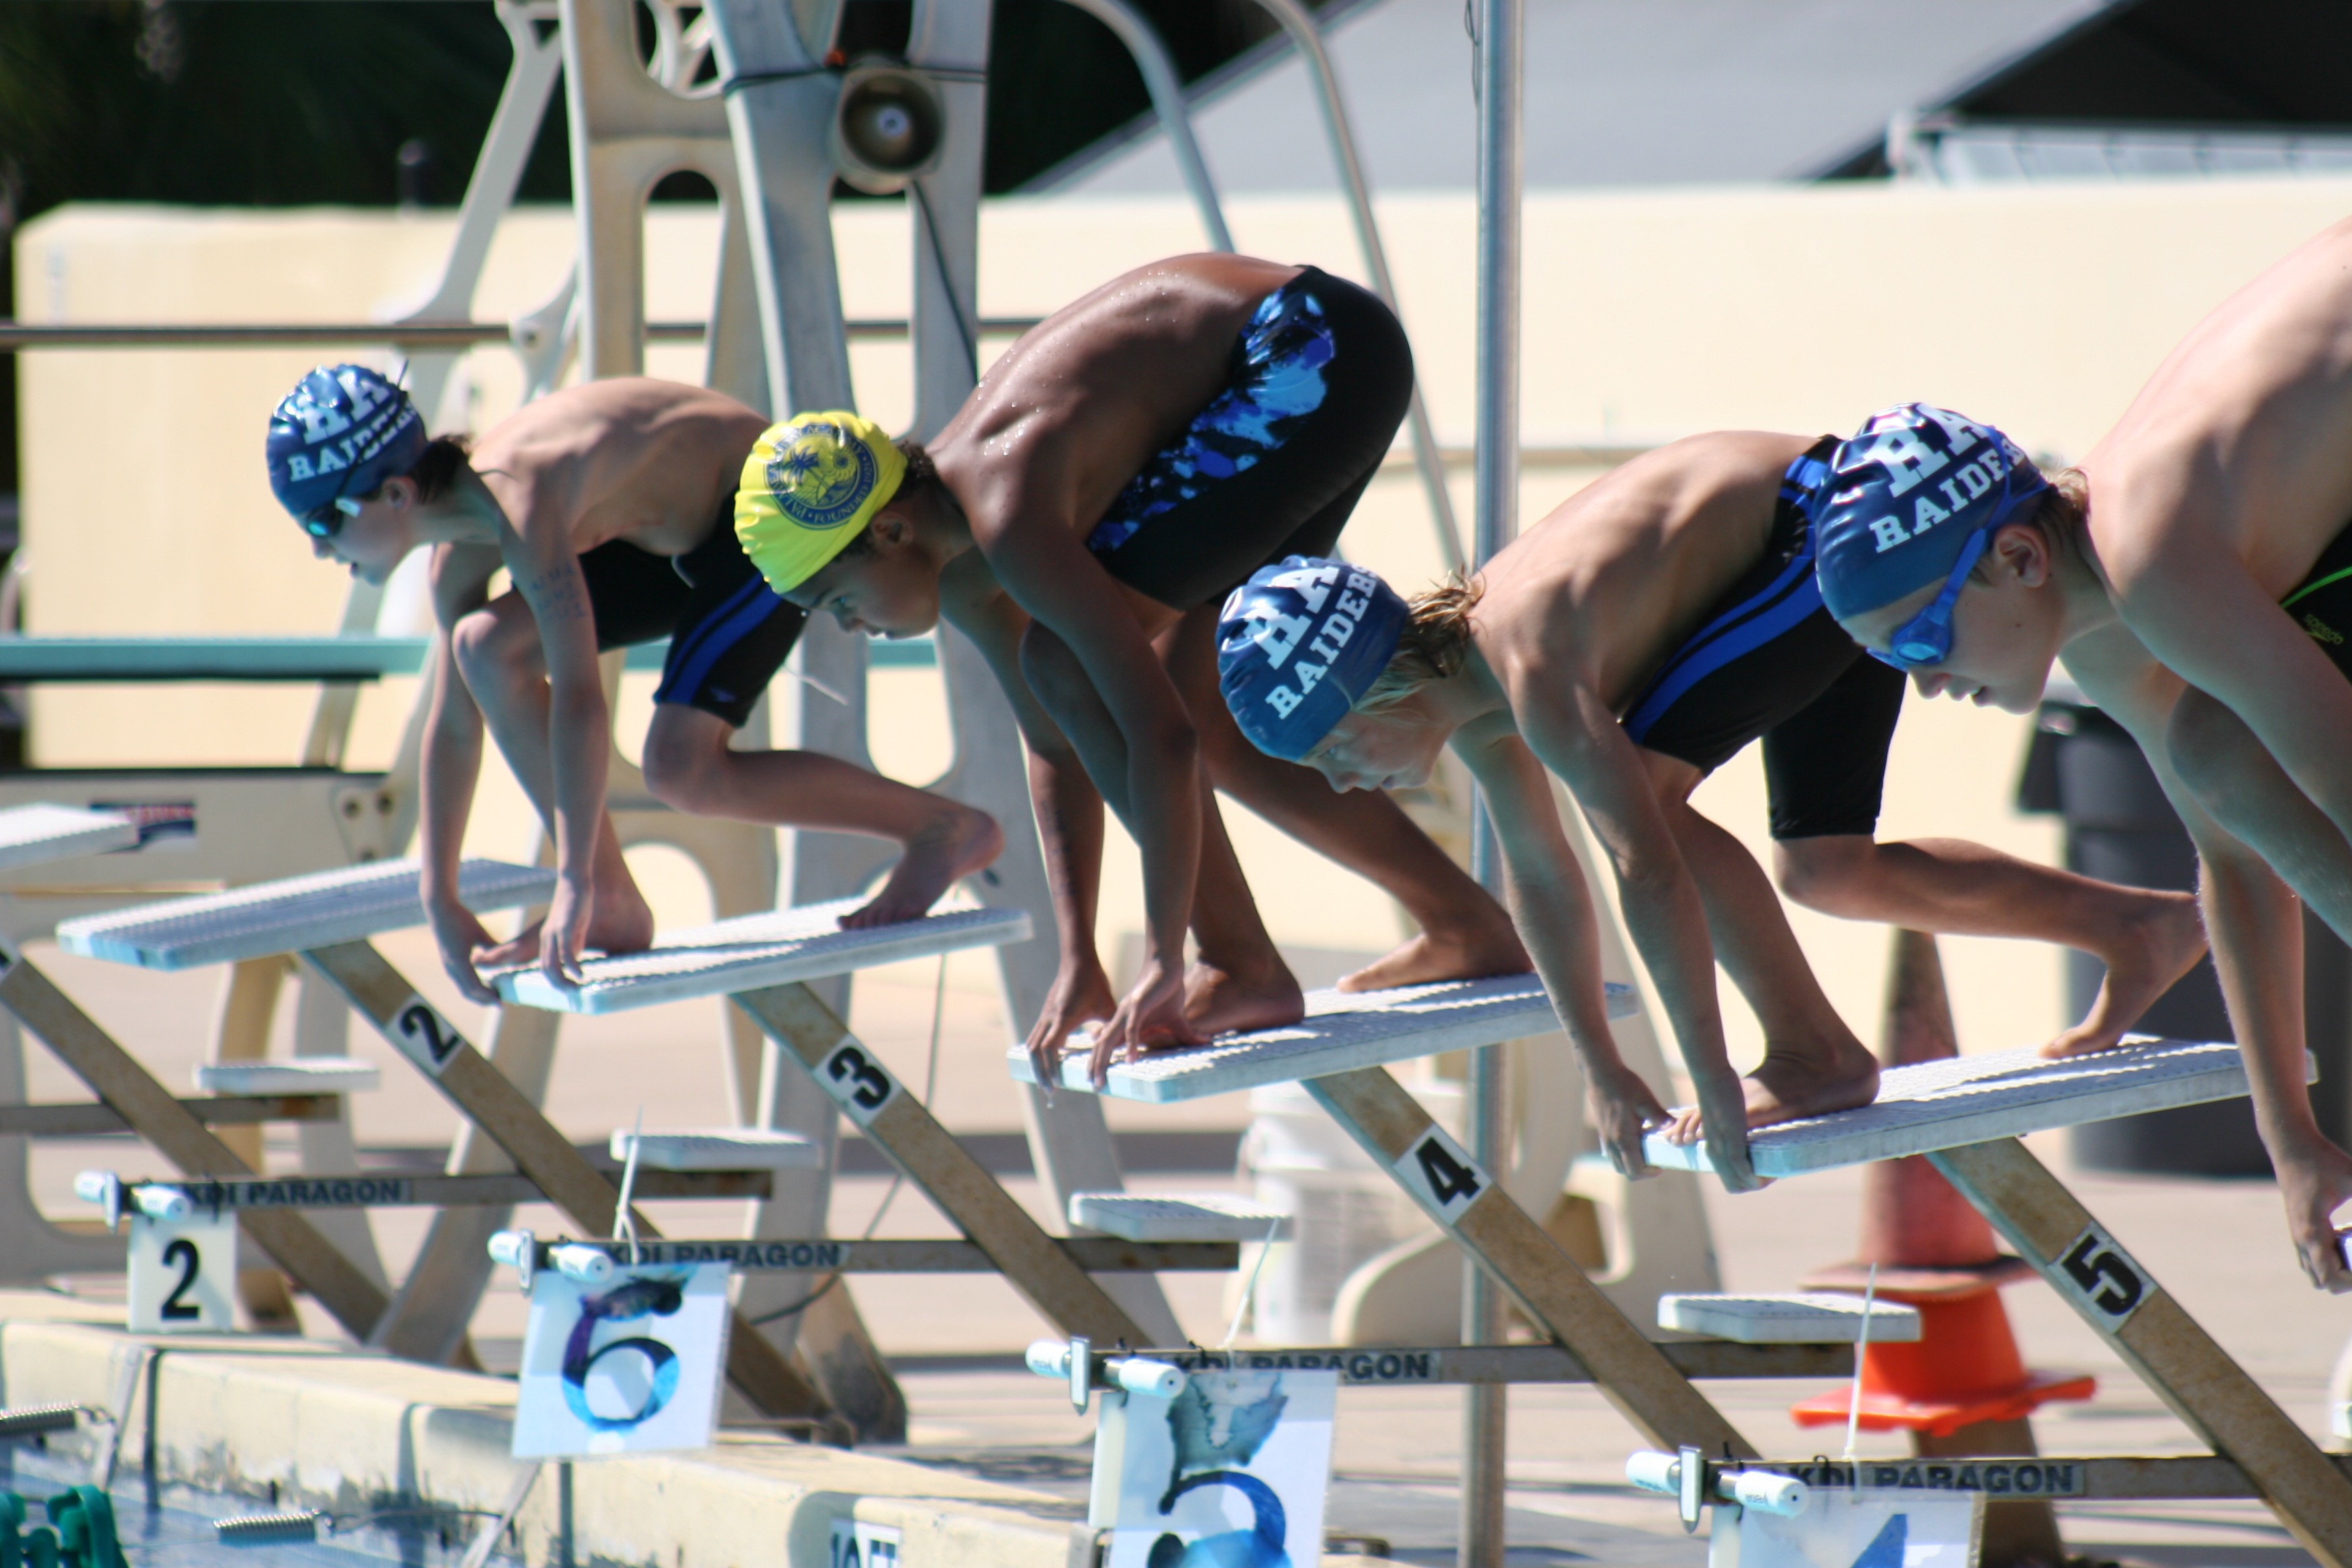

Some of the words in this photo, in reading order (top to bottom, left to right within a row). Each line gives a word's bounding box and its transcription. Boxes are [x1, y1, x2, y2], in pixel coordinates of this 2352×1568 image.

[2304, 614, 2343, 644] speedo
[399, 1003, 460, 1064] 2
[828, 1047, 891, 1109] 3
[248, 1180, 401, 1204] PARAGON
[1416, 1136, 1480, 1206] 4
[160, 1239, 199, 1320] 2
[675, 1244, 839, 1267] PARAGON
[2061, 1234, 2143, 1316] 5
[1875, 1465, 2073, 1493] PARAGON
